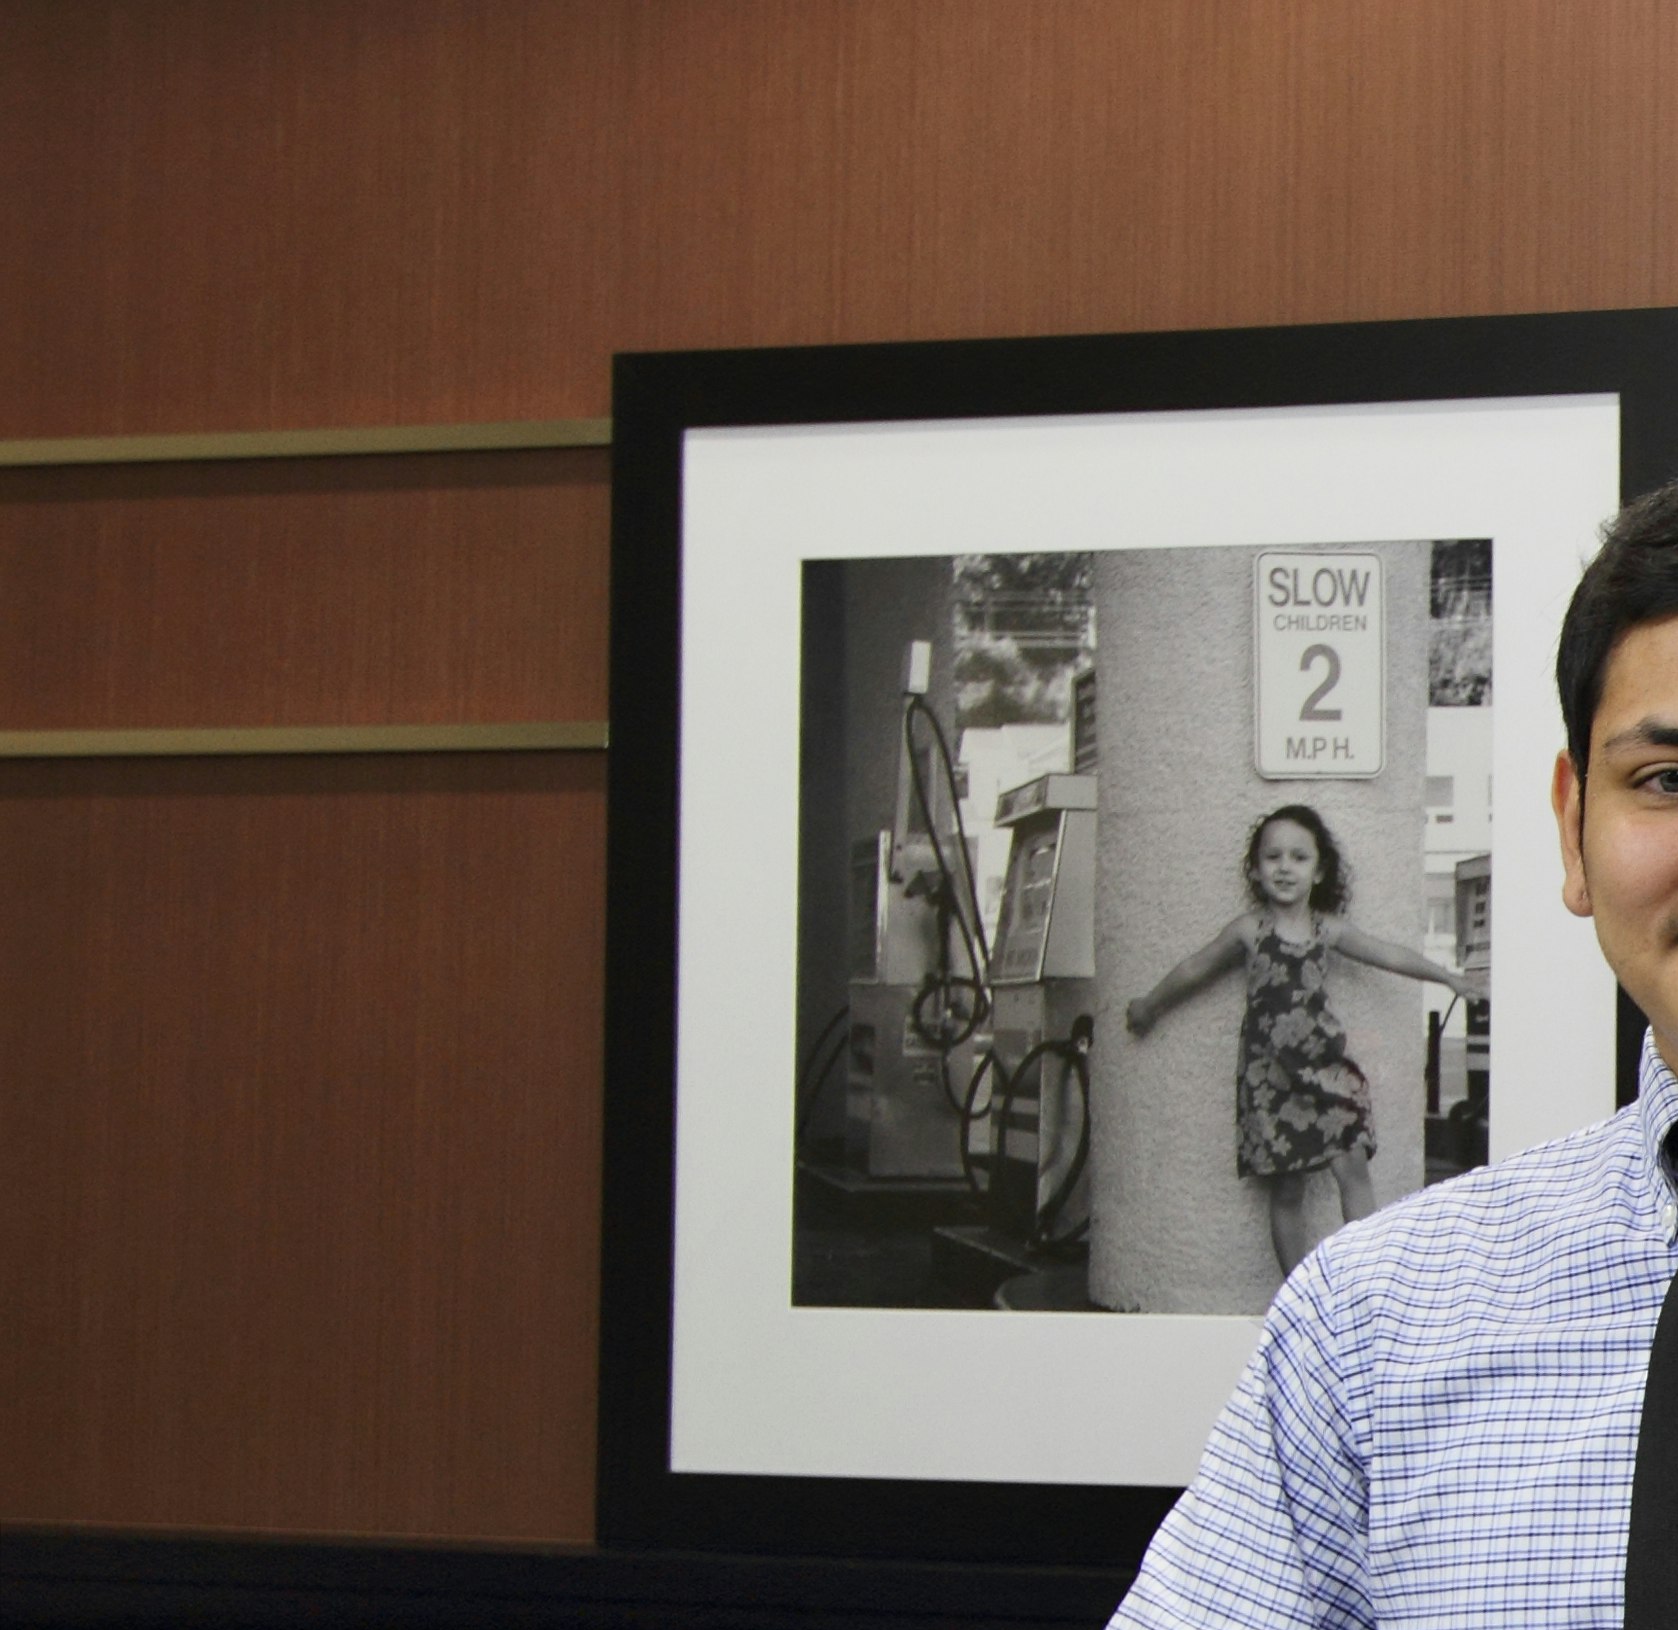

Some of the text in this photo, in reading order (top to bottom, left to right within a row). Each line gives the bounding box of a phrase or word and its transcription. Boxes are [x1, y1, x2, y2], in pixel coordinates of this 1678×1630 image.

[1268, 567, 1371, 608] SLOW
[1273, 614, 1367, 632] CHILDREN
[1299, 643, 1343, 722] 2
